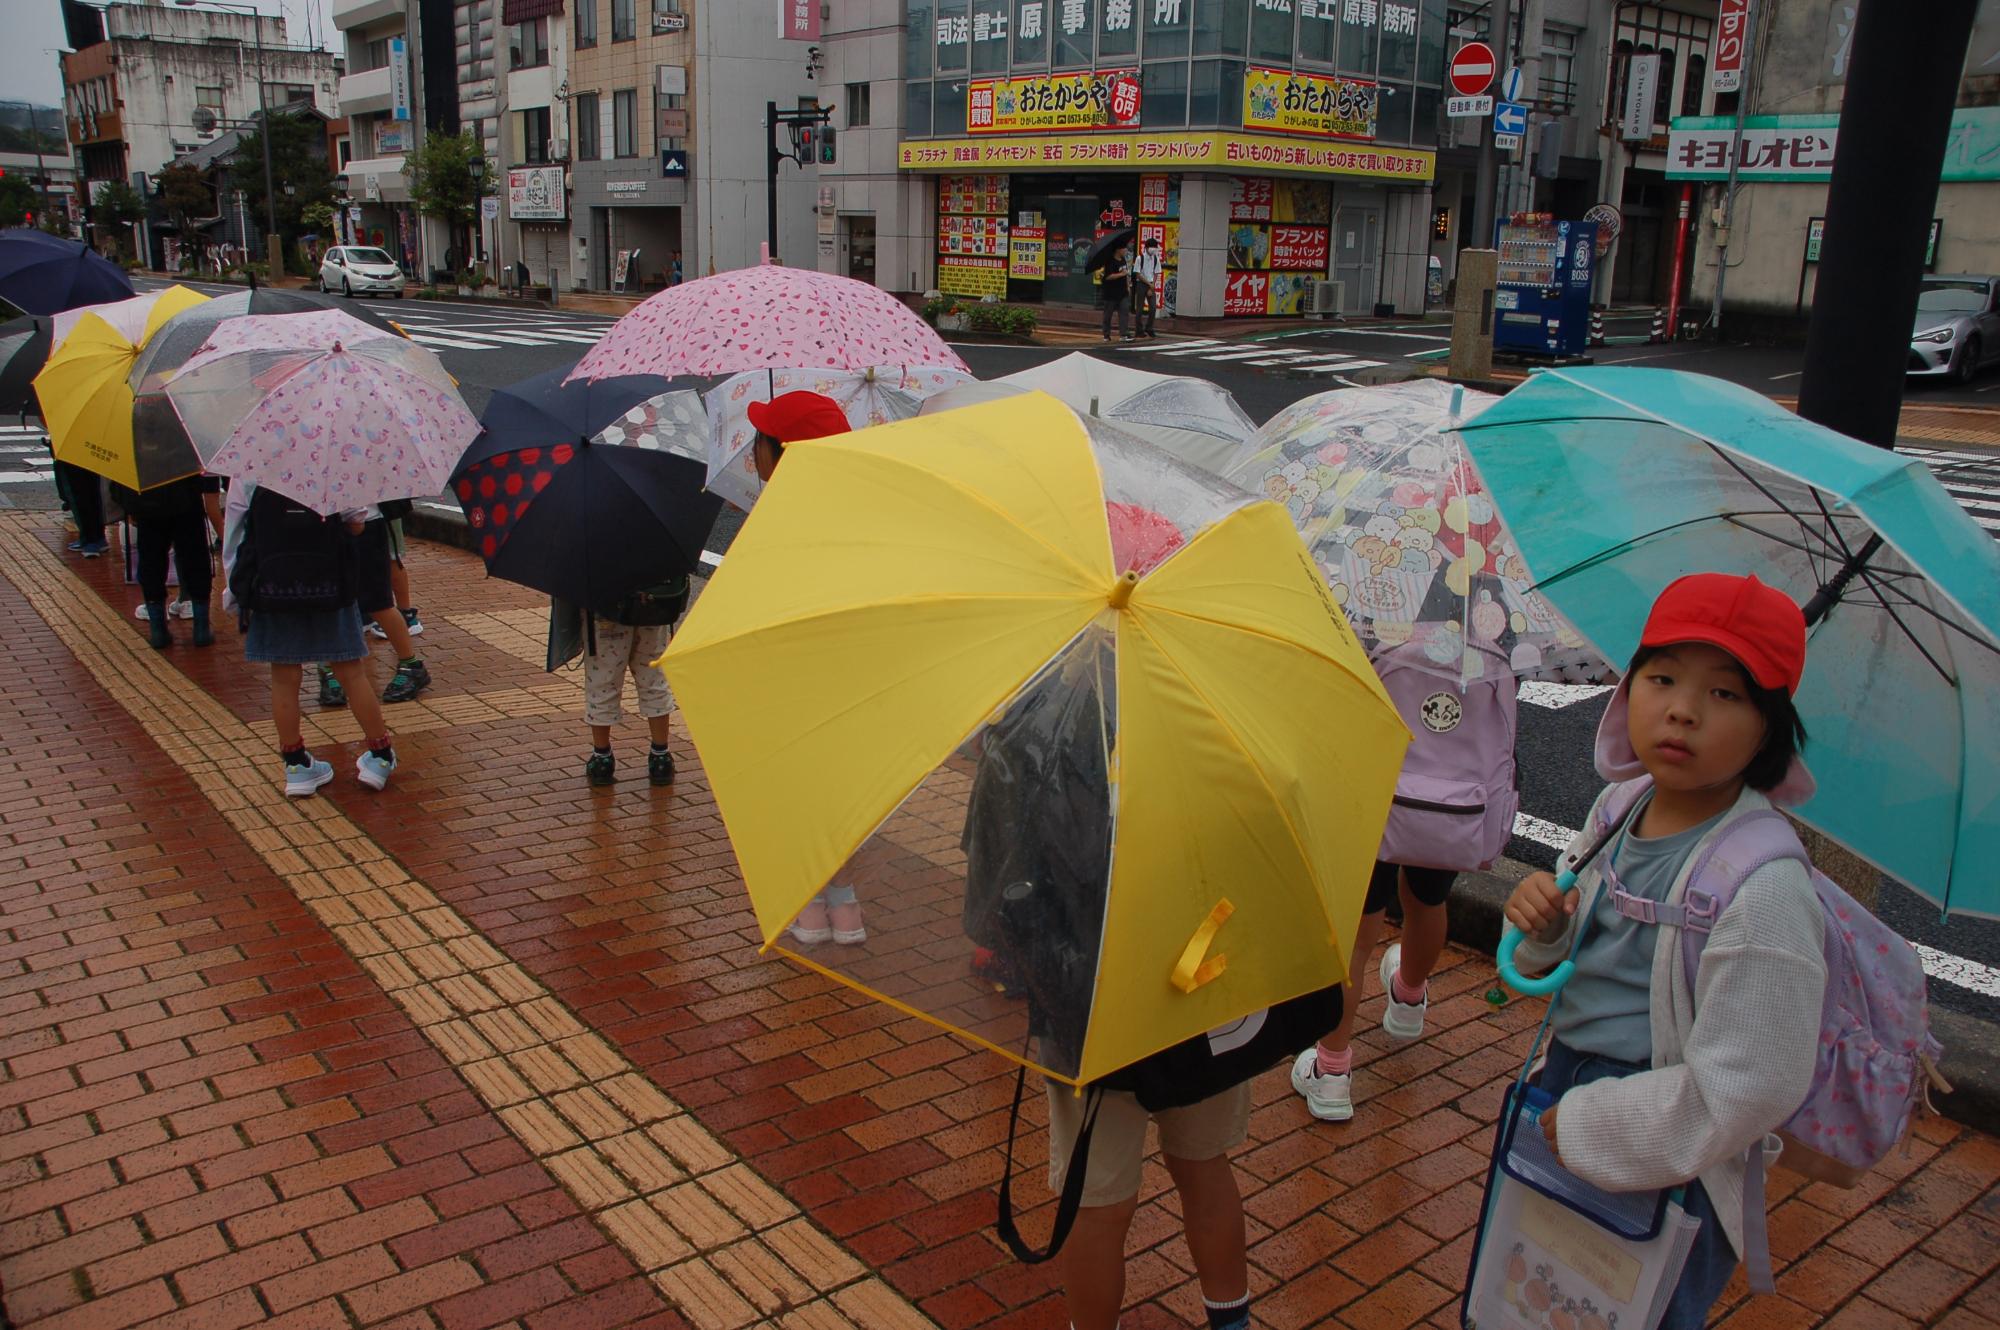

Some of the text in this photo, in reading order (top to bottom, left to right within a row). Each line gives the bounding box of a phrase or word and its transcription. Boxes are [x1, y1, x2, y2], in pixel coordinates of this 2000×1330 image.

[1342, 0, 1416, 36] 原事務所
[937, 10, 1007, 46] 司法書士
[1719, 0, 1746, 62] すり
[971, 90, 992, 107] 高価
[1020, 80, 1107, 113] おたからや
[1116, 82, 1137, 100] 査定
[1283, 81, 1369, 119] おたからや
[1450, 101, 1489, 113] 自動車・原付
[971, 108, 992, 126] 買取
[1020, 115, 1053, 125] ひがしみの店
[1284, 116, 1318, 128] ひがしみの店
[903, 141, 1212, 162] 金 プラチナ 貴金属 ダイヤモンド 宝石 ブランド時計 ブランドバッグ
[1143, 179, 1165, 196] 高価
[1248, 179, 1271, 190] プラ
[1142, 197, 1165, 213] 買取
[1247, 191, 1271, 203] チナ
[1230, 204, 1271, 220] 金属
[1275, 229, 1325, 245] ブランド
[1273, 246, 1325, 257] 時計・バッグ
[1272, 258, 1324, 268] ブランド小物
[1571, 269, 1589, 281] BOSS
[1224, 298, 1265, 308] メラルド
